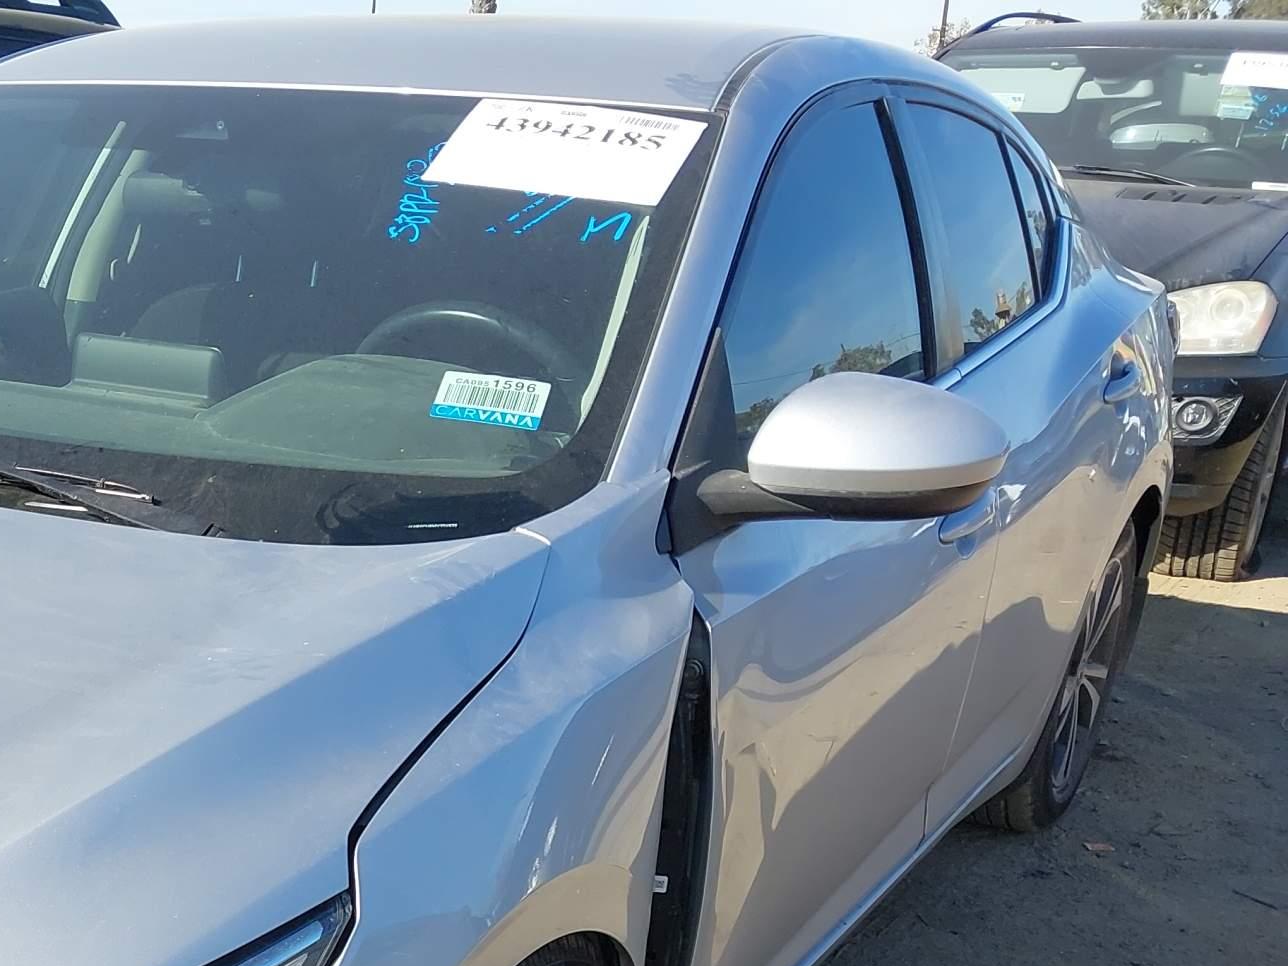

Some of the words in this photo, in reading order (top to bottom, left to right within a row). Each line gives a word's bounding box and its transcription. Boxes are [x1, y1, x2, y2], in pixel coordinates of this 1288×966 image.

[486, 117, 666, 150] 43942185
[493, 379, 537, 393] 1596
[435, 405, 533, 428] CARVANA
